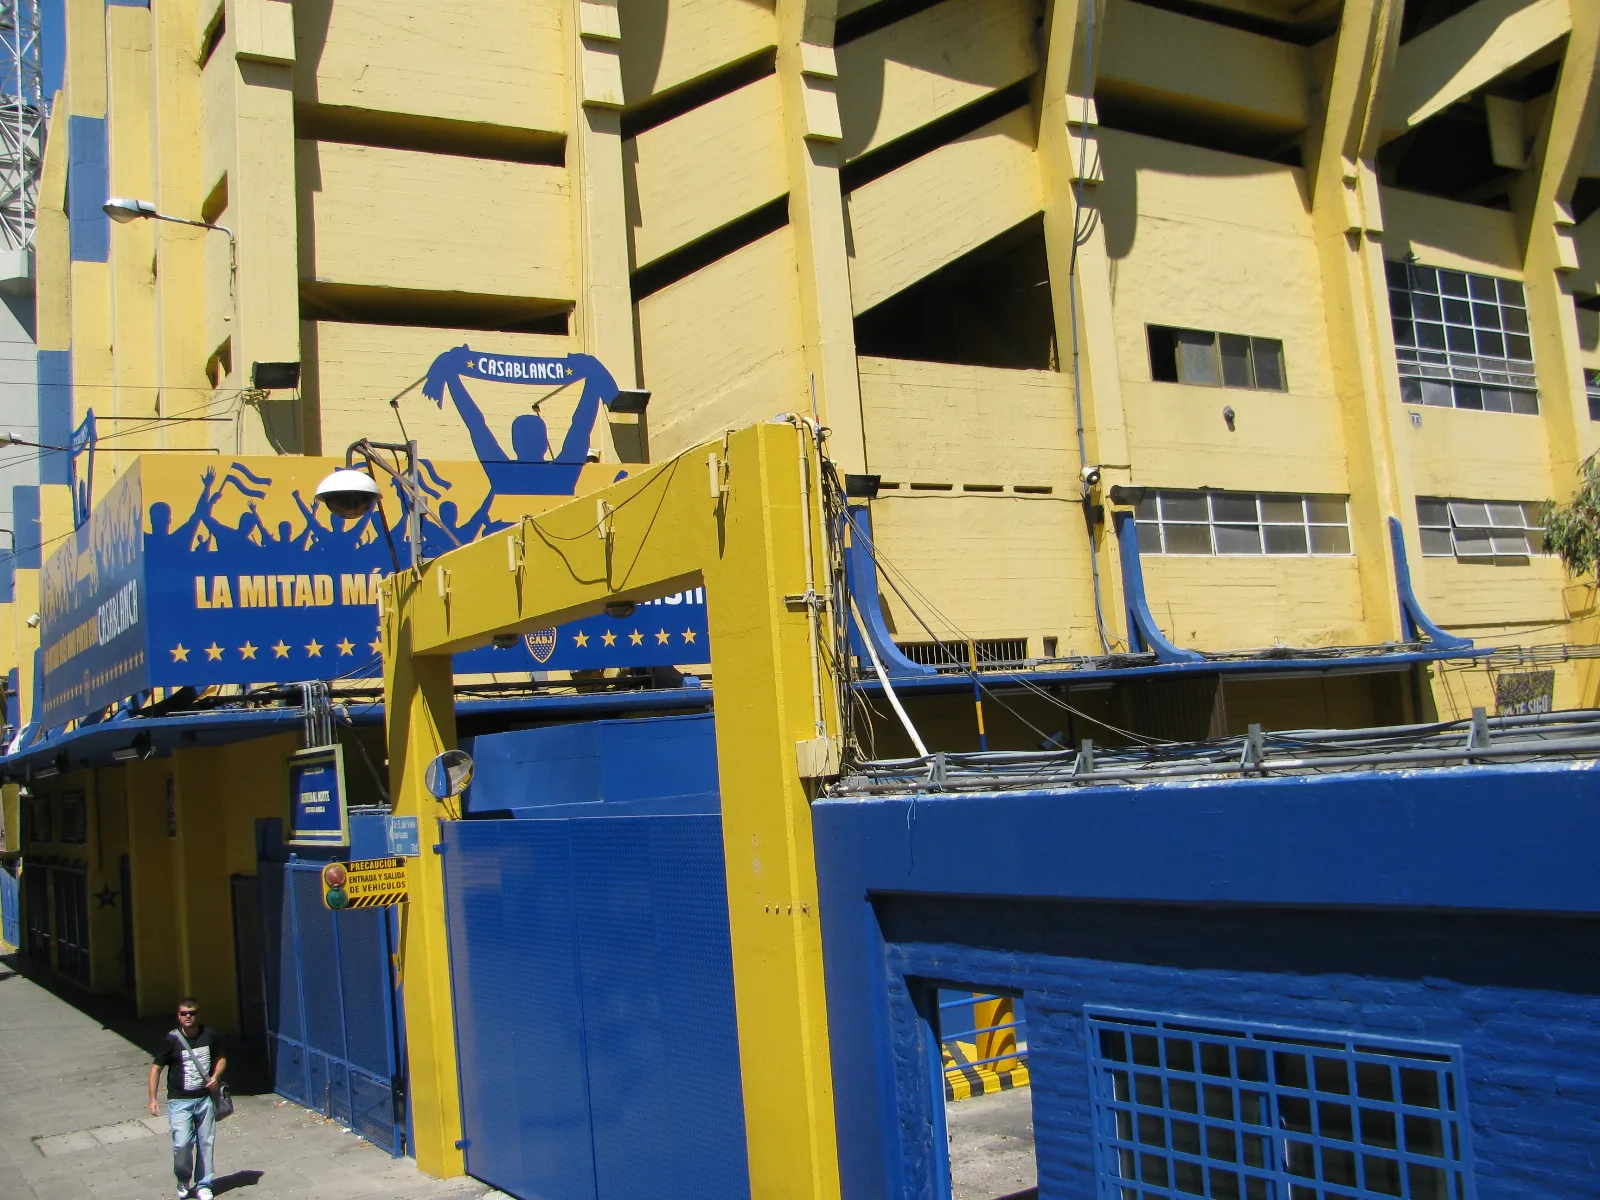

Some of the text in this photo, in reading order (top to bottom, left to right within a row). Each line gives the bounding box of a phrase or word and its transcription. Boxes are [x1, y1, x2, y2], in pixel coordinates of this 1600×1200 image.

[478, 357, 564, 379] CASABLANCA
[196, 567, 384, 609] LA MITAD MÁ
[98, 578, 138, 647] CASABLANCA
[529, 635, 553, 645] CABJ
[350, 859, 397, 872] PRECAUCION
[349, 871, 406, 884] ENTRADA Y SALIDA
[350, 880, 407, 894] DE VEHICULOS
